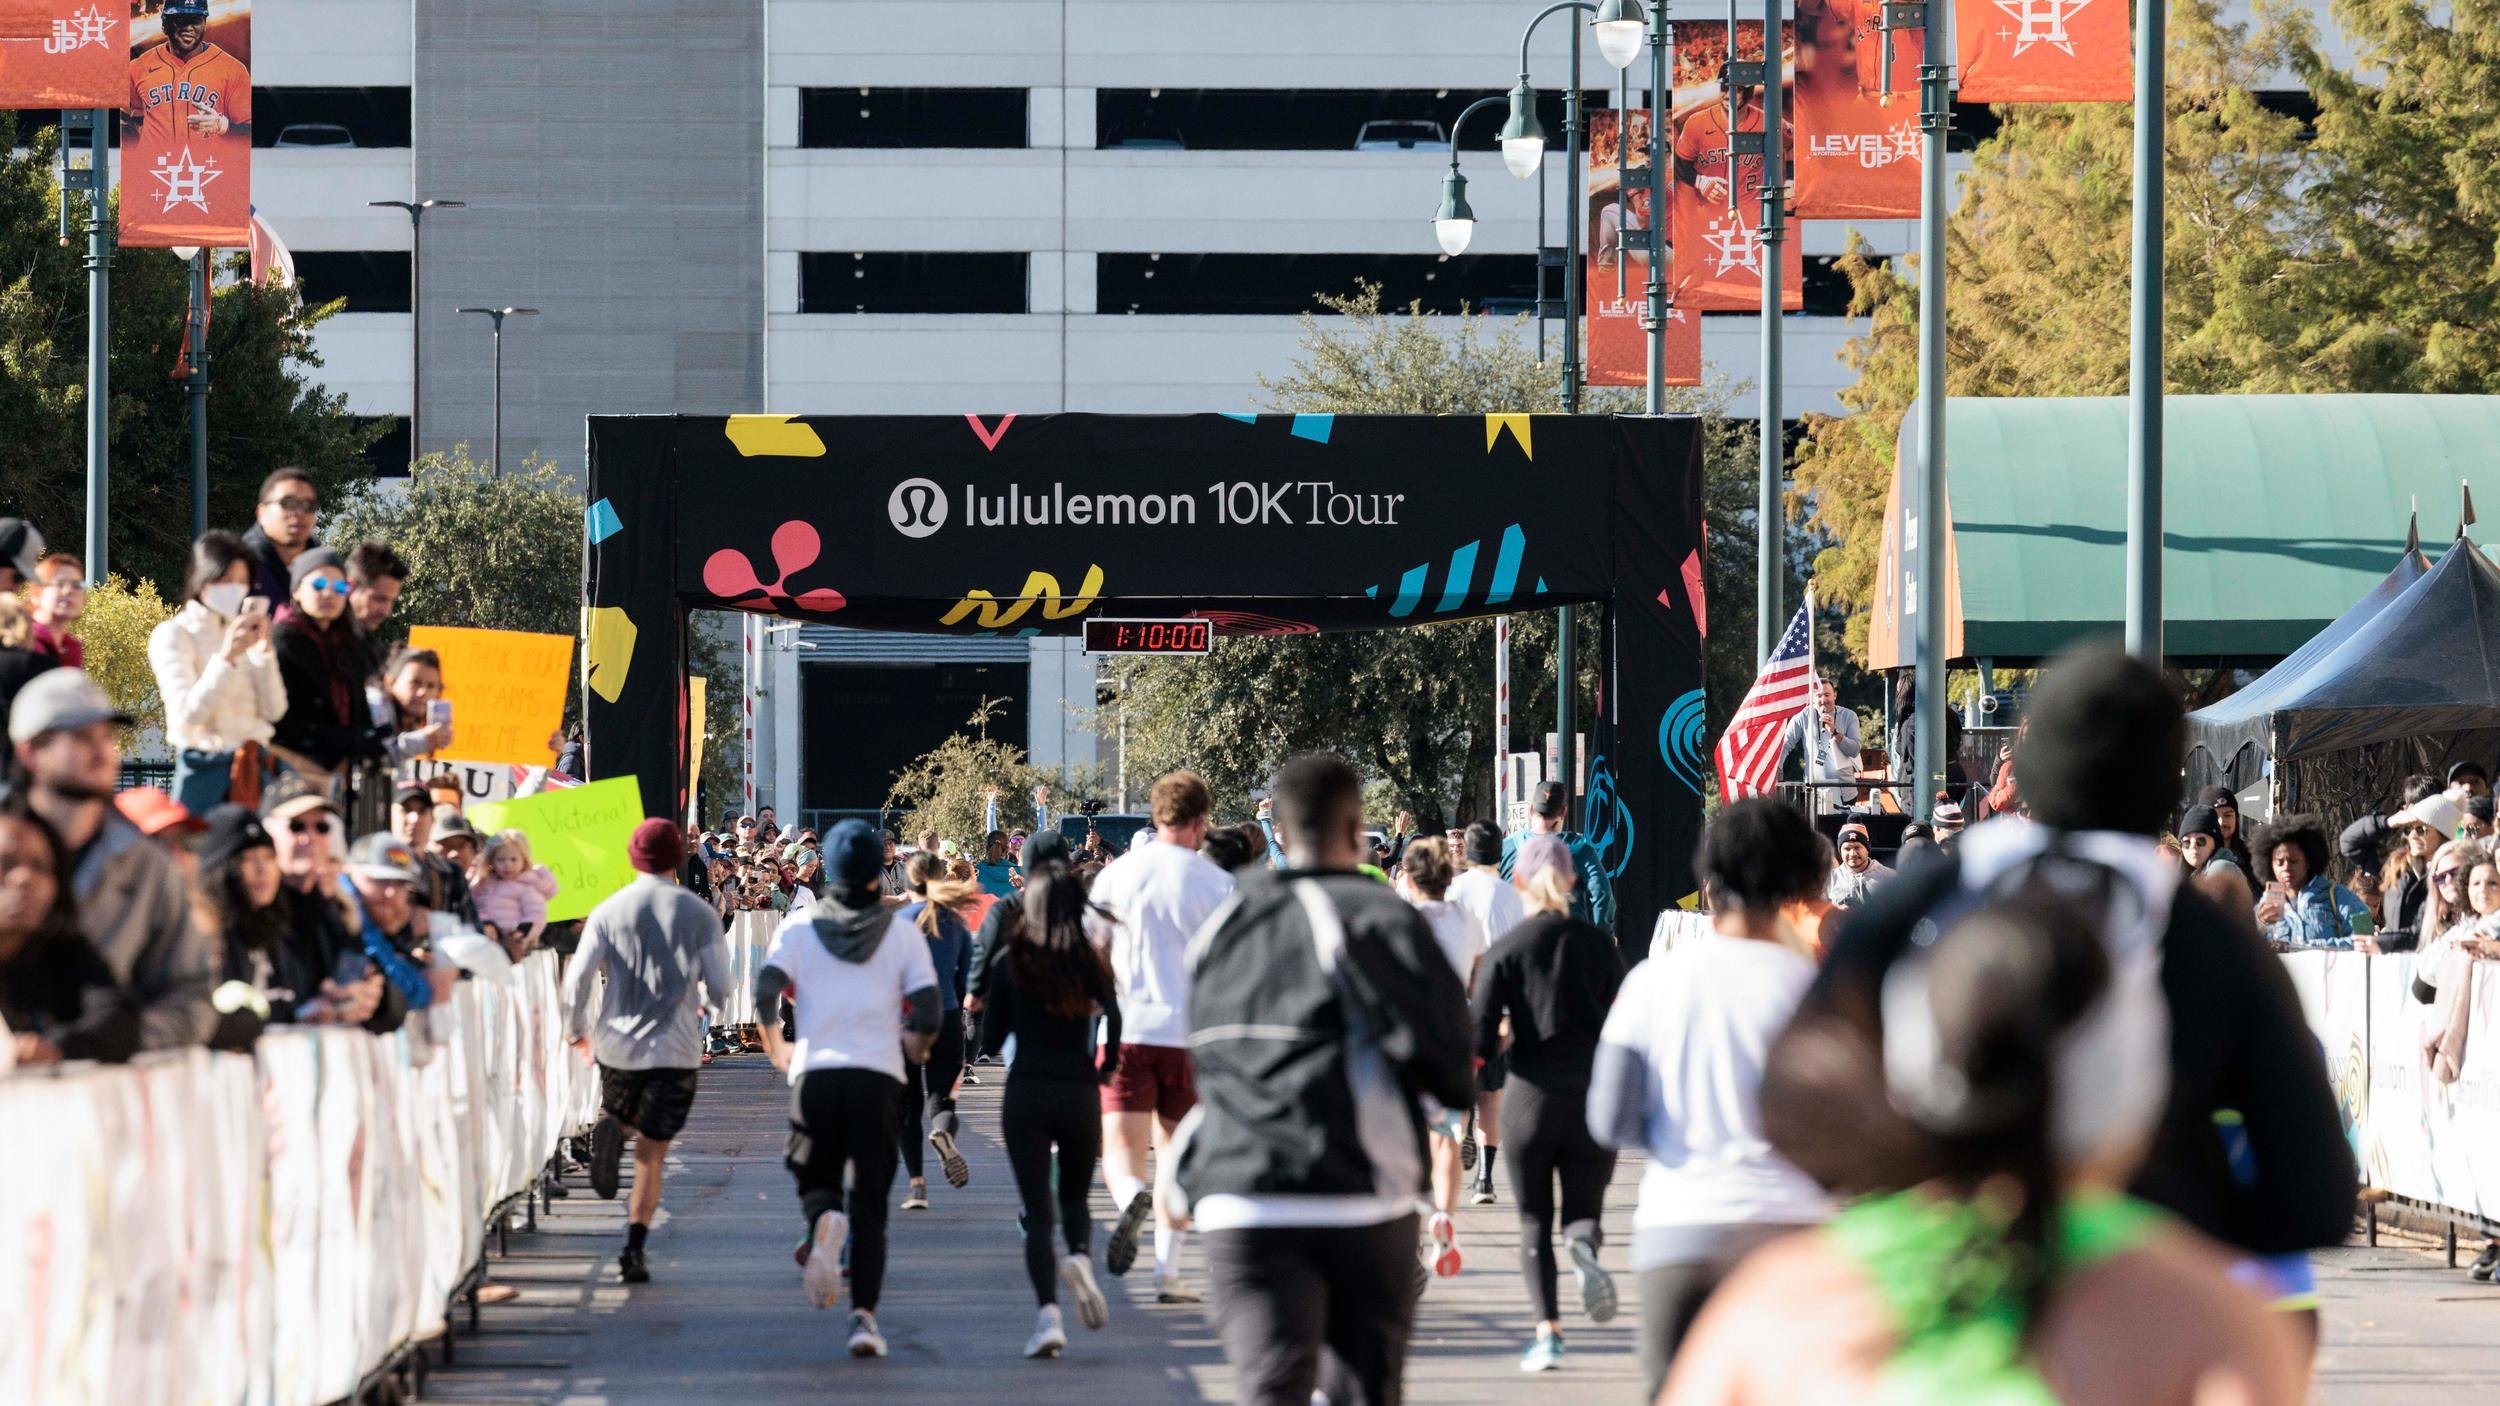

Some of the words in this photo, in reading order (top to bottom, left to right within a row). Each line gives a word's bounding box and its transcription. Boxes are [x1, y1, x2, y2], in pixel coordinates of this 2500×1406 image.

[44, 37, 78, 54] UP
[1810, 134, 1893, 152] LEVEL
[1696, 147, 1763, 170] ASTOS
[1860, 151, 1893, 168] UP
[1599, 300, 1648, 315] LEVE
[966, 482, 1196, 526] lululemon
[1207, 480, 1294, 525] 10K
[1296, 480, 1405, 525] Tour
[1117, 624, 1206, 649] 1:10:00
[573, 861, 599, 891] do
